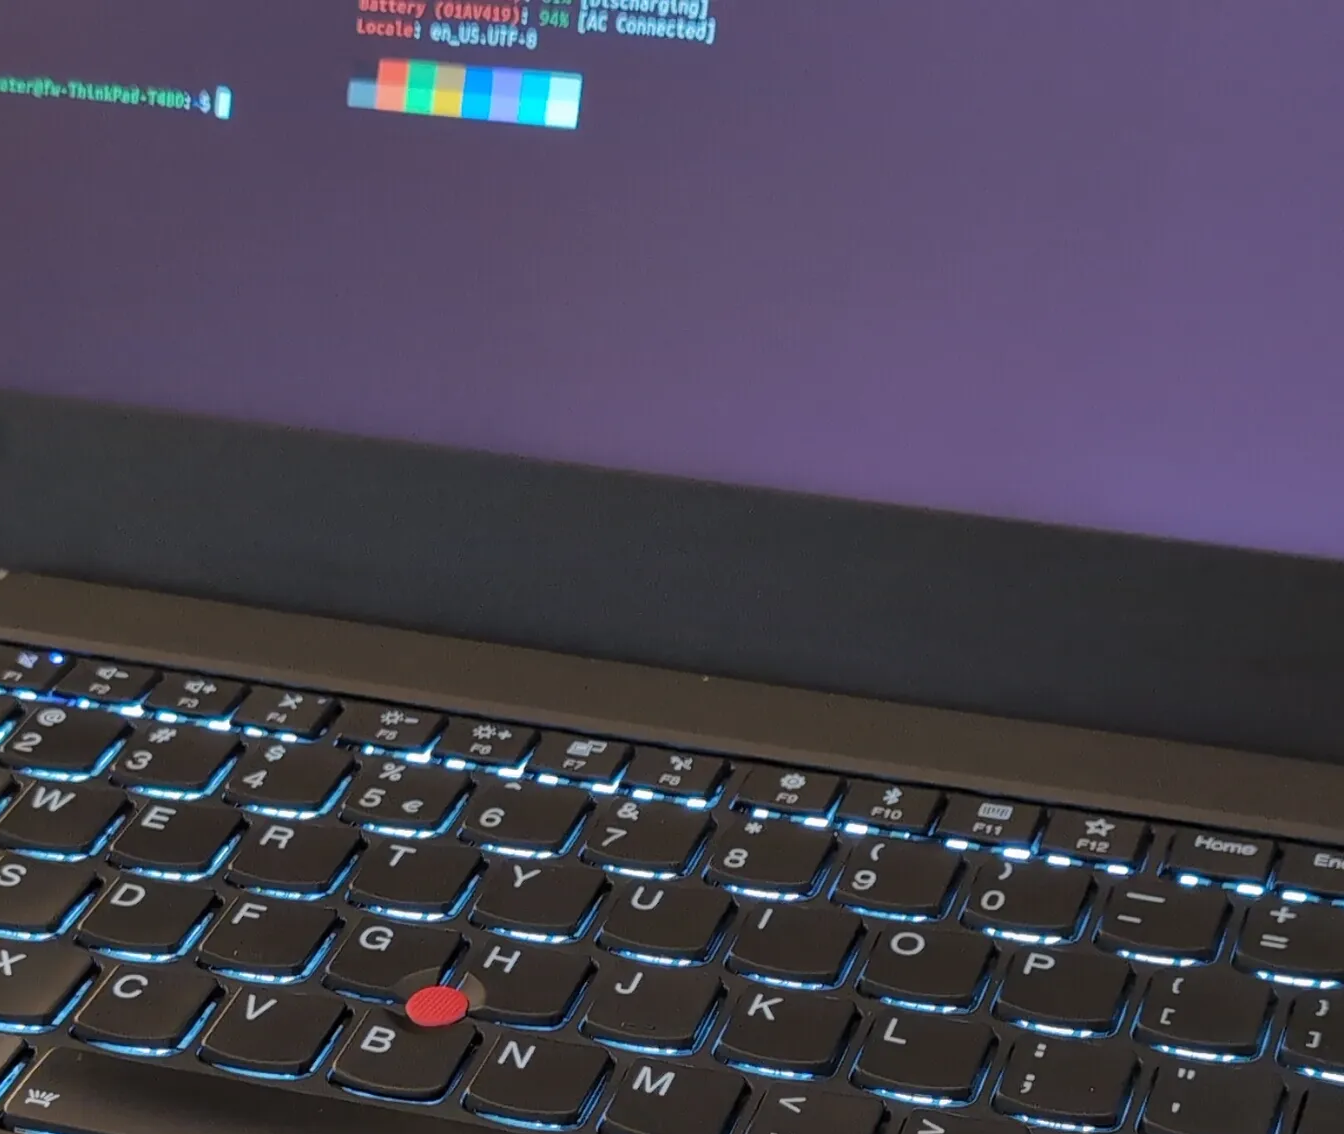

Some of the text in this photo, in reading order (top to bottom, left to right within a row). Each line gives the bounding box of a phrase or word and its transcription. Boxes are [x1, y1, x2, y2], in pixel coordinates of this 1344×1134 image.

[356, 18, 421, 39] Locale:
[358, 0, 426, 18] Battery
[539, 9, 570, 28] 94%
[577, 9, 608, 33] [AC
[616, 12, 716, 44] Connected]
[2, 670, 22, 681] F1
[178, 697, 199, 709] F3
[37, 708, 67, 726] @
[266, 713, 287, 724] F4
[13, 733, 43, 753] 2
[148, 727, 177, 744] #
[126, 751, 153, 770] 3
[265, 745, 286, 762] $
[378, 763, 406, 782] %
[563, 758, 586, 770] F7
[243, 771, 268, 789] 4
[31, 786, 76, 811] W
[359, 789, 387, 808] 5
[776, 793, 799, 804] F9
[141, 807, 177, 830] E
[479, 808, 506, 828] 6
[617, 803, 639, 821] &
[871, 806, 902, 821] F10
[259, 826, 295, 849] R
[602, 827, 627, 847] 7
[972, 822, 1002, 836] F11
[870, 843, 885, 861] (
[1076, 838, 1110, 853] F12
[1194, 835, 1258, 857] Home
[388, 845, 417, 867] T
[723, 848, 748, 868] 8
[512, 865, 541, 888] Y
[851, 870, 877, 890] 9
[999, 863, 1013, 880] )
[109, 883, 146, 907] D
[630, 887, 665, 911] U
[231, 903, 268, 925] F
[1270, 905, 1297, 924] +
[359, 926, 395, 951] G
[890, 931, 926, 956] O
[1260, 933, 1290, 950] =
[483, 946, 521, 973] H
[1023, 953, 1055, 976] P
[112, 974, 148, 999] C
[615, 972, 643, 995] J
[244, 994, 278, 1021] V
[747, 994, 784, 1021] K
[1160, 1008, 1176, 1026] [
[360, 1026, 396, 1054] B
[883, 1019, 907, 1044] L
[1306, 1031, 1322, 1049] ]
[497, 1041, 537, 1069] N
[632, 1066, 676, 1097] M
[779, 1095, 807, 1113] <
